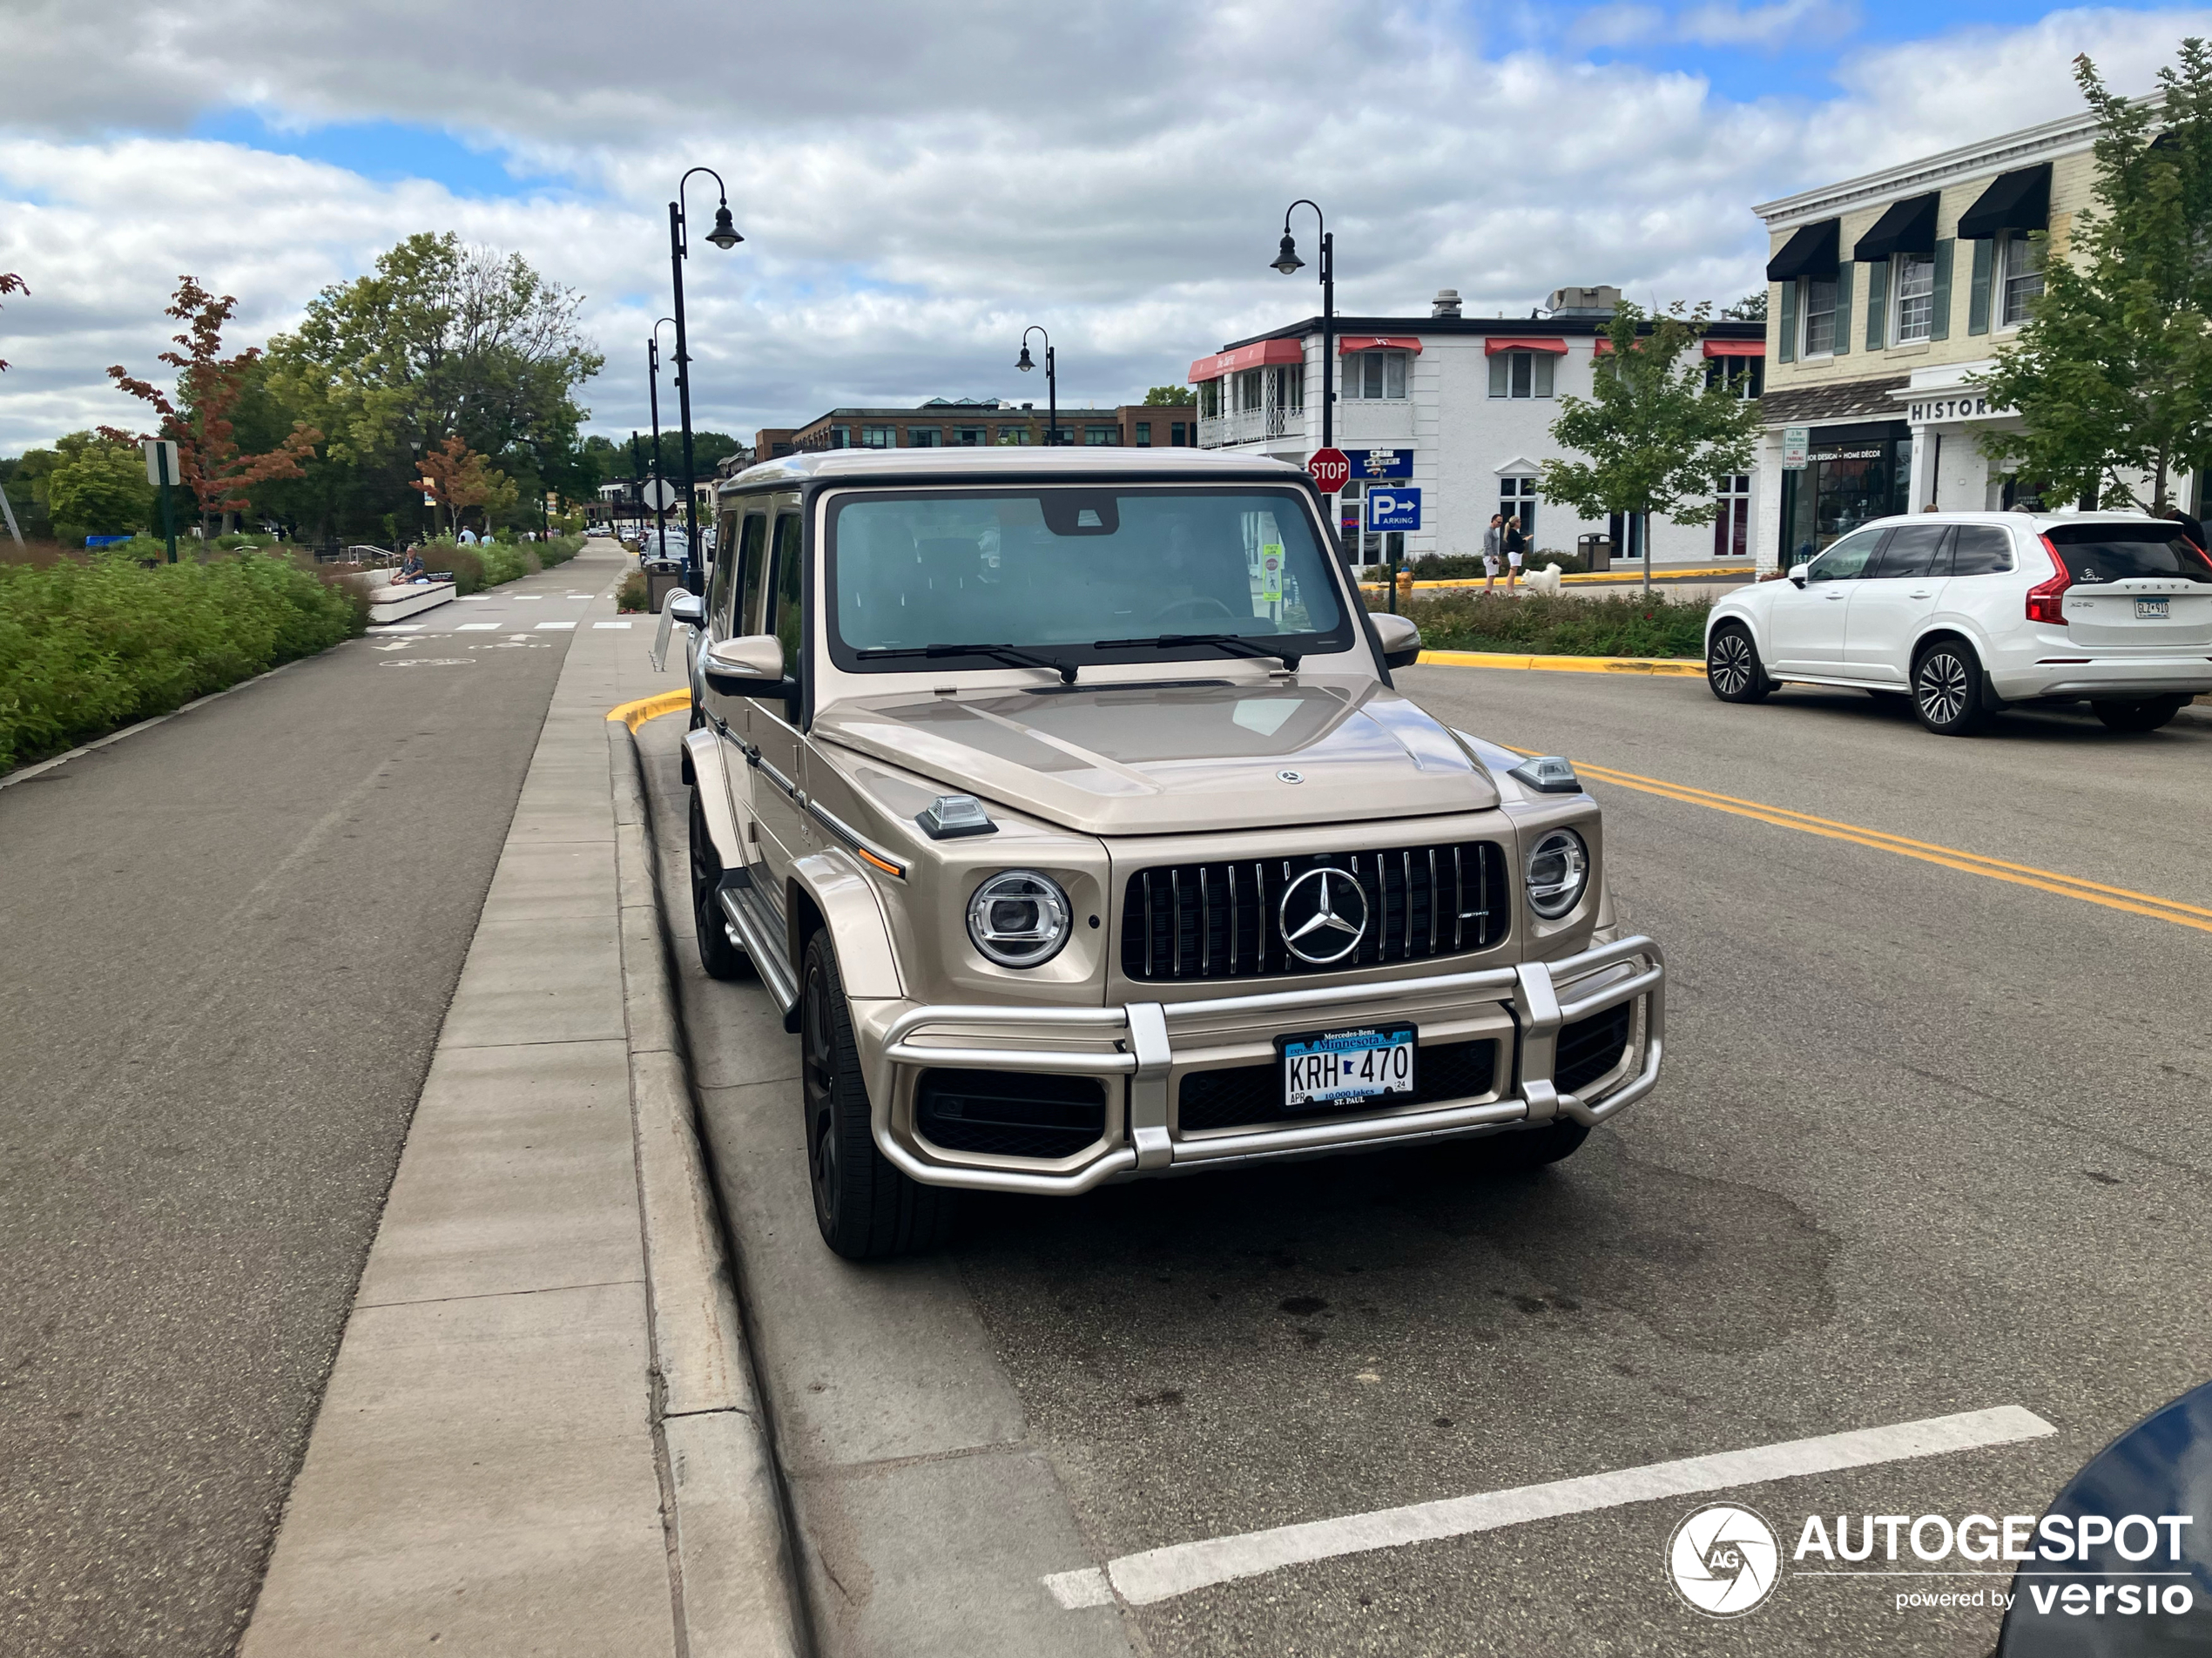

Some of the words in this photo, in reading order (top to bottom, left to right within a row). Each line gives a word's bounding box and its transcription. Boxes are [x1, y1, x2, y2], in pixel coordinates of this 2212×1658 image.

[1861, 449, 1880, 458] DÉCOR
[1312, 462, 1347, 479] STOP
[1324, 1029, 1375, 1040] Mercedes-Benz
[1290, 1053, 1339, 1092] KRH
[1359, 1046, 1408, 1082] 470
[1291, 1092, 1305, 1103] APR
[1325, 1090, 1350, 1099] 10,000
[1353, 1089, 1374, 1098] lakes
[1346, 1096, 1365, 1105] PAUL
